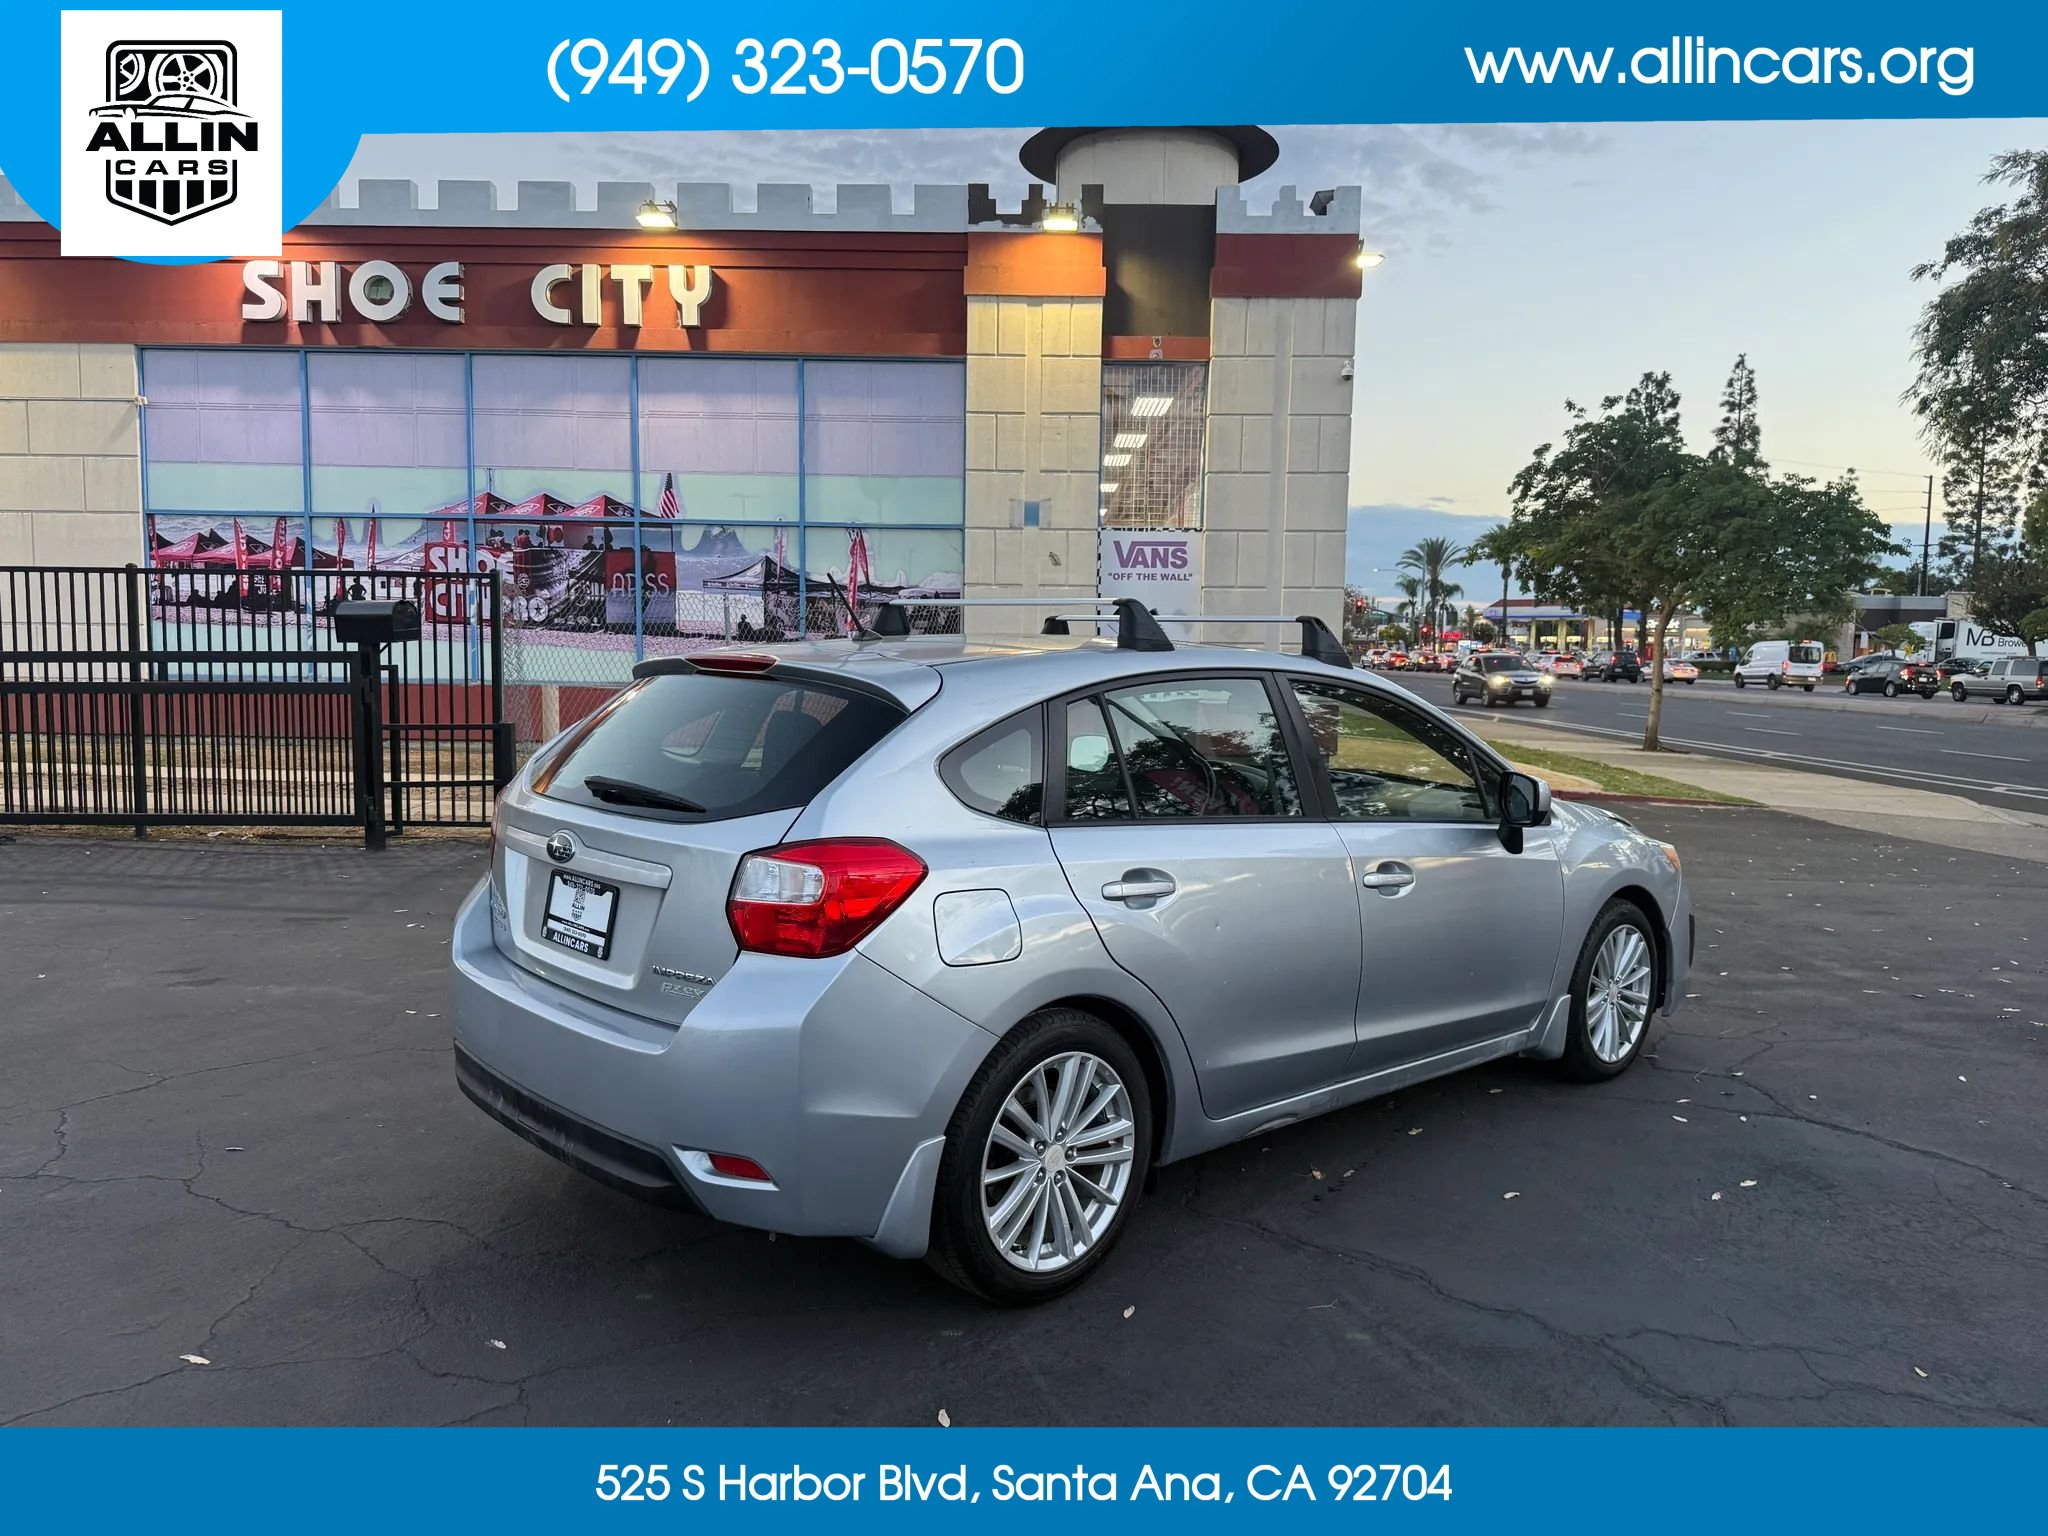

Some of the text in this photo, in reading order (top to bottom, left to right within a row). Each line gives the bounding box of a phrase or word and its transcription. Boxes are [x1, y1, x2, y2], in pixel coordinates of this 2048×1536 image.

[242, 260, 712, 327] SHOE CITY
[1113, 541, 1188, 569] VANS
[1136, 573, 1157, 581] THE
[552, 932, 589, 952] ALLINCARS
[652, 965, 716, 986] IMPREZA
